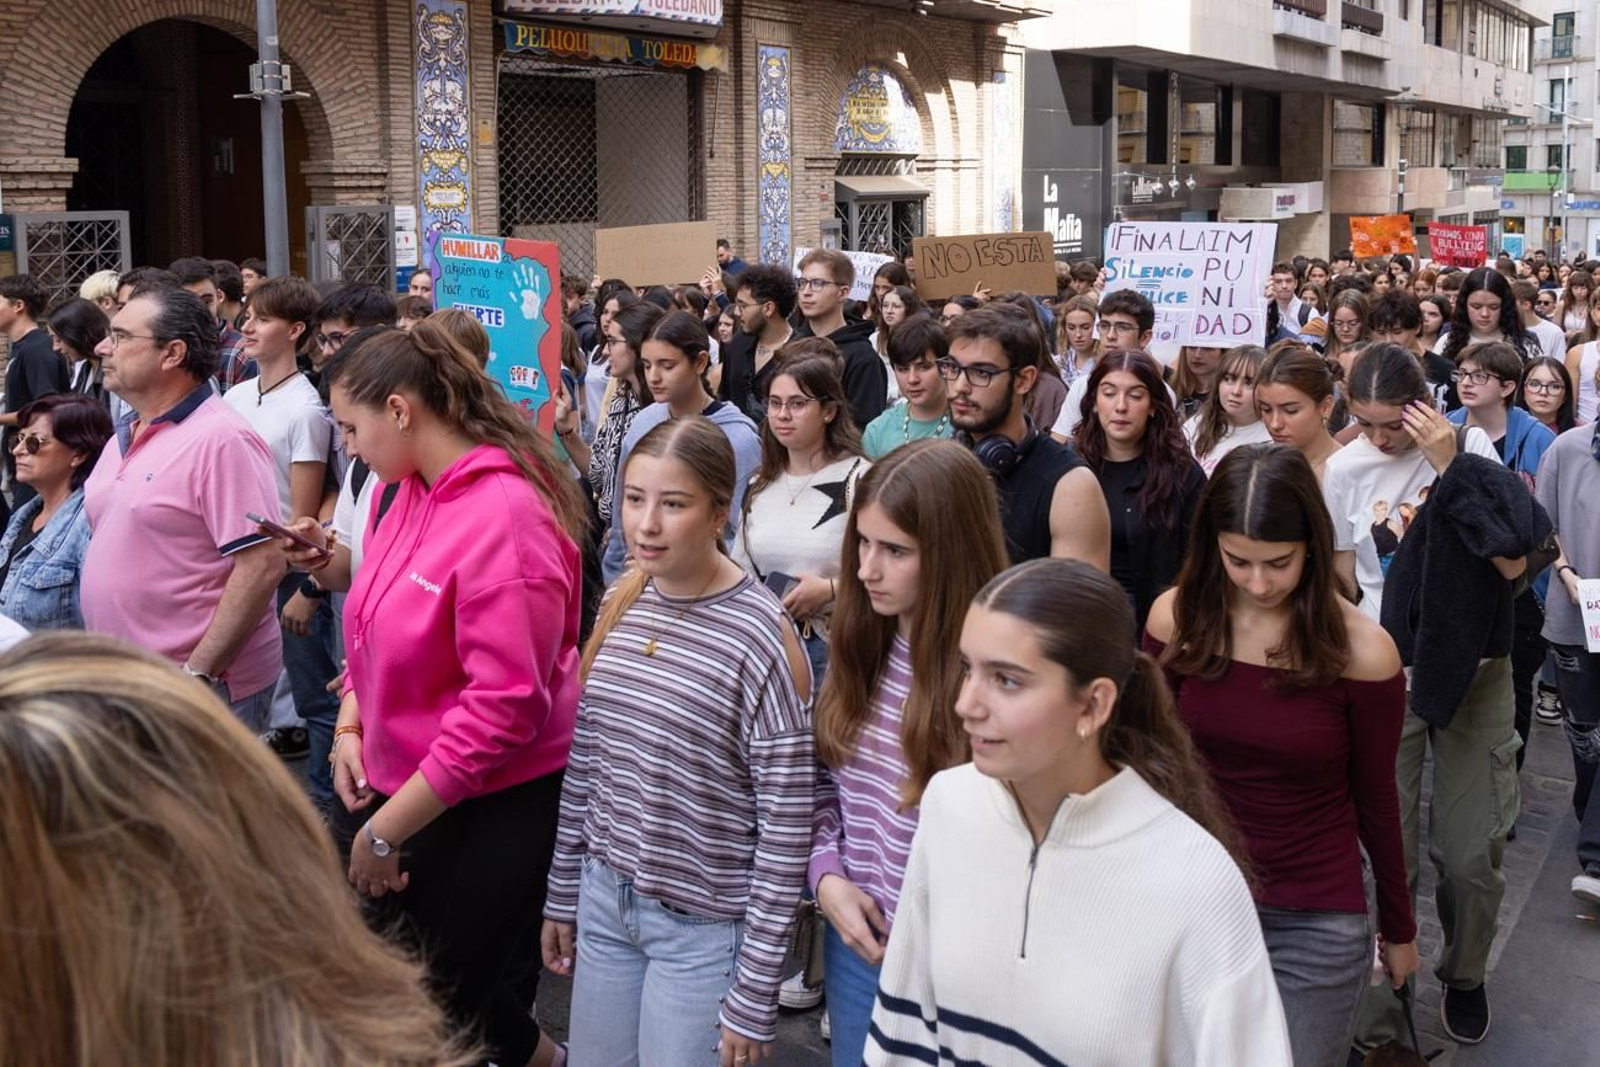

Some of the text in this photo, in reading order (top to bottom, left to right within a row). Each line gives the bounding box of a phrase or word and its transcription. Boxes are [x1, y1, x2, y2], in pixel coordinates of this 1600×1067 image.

[1043, 174, 1058, 202] La
[1044, 207, 1082, 242] Mafia
[442, 239, 511, 265] HUMILLAR a
[922, 236, 1044, 279] NO ESTA
[445, 263, 505, 282] alguien no te
[1203, 257, 1243, 281] PU
[443, 278, 490, 300] hace más
[1195, 313, 1252, 336] DAD
